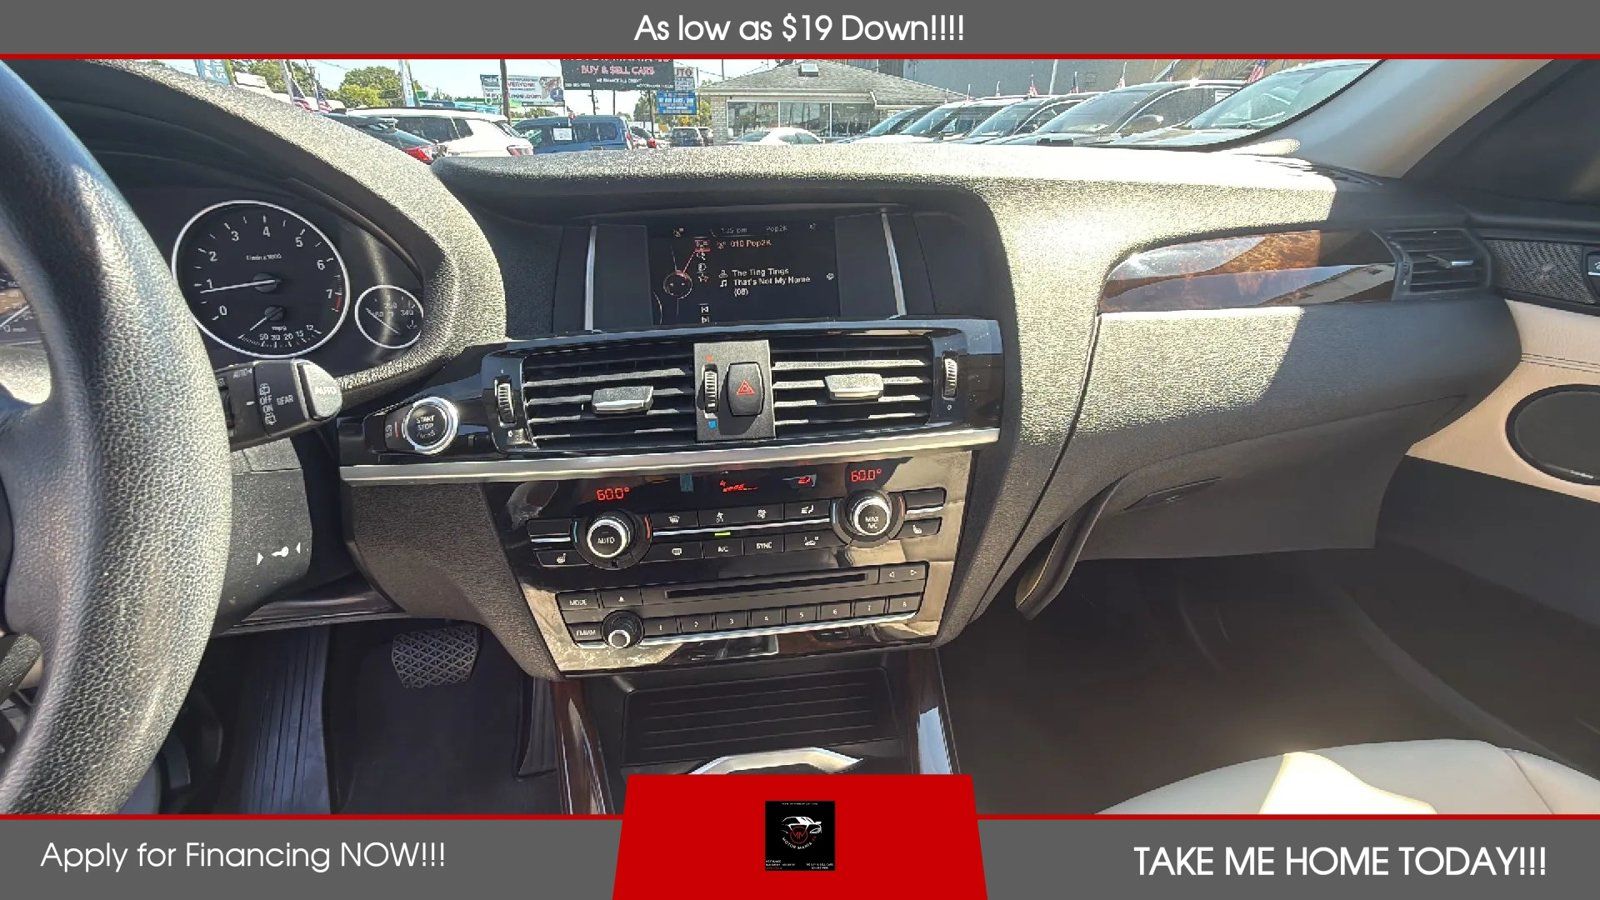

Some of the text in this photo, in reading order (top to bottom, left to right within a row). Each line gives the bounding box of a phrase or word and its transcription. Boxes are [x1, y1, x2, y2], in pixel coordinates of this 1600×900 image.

[230, 230, 240, 242] 3
[262, 226, 271, 238] 4
[295, 236, 304, 248] 5
[208, 251, 218, 262] 2
[316, 259, 326, 271] 6
[731, 267, 789, 278] The Ting Tings
[206, 278, 214, 289] 1
[733, 278, 757, 287] That's
[759, 278, 773, 286] Not
[774, 277, 787, 287] My
[326, 288, 333, 299] 7
[219, 305, 228, 316] 0
